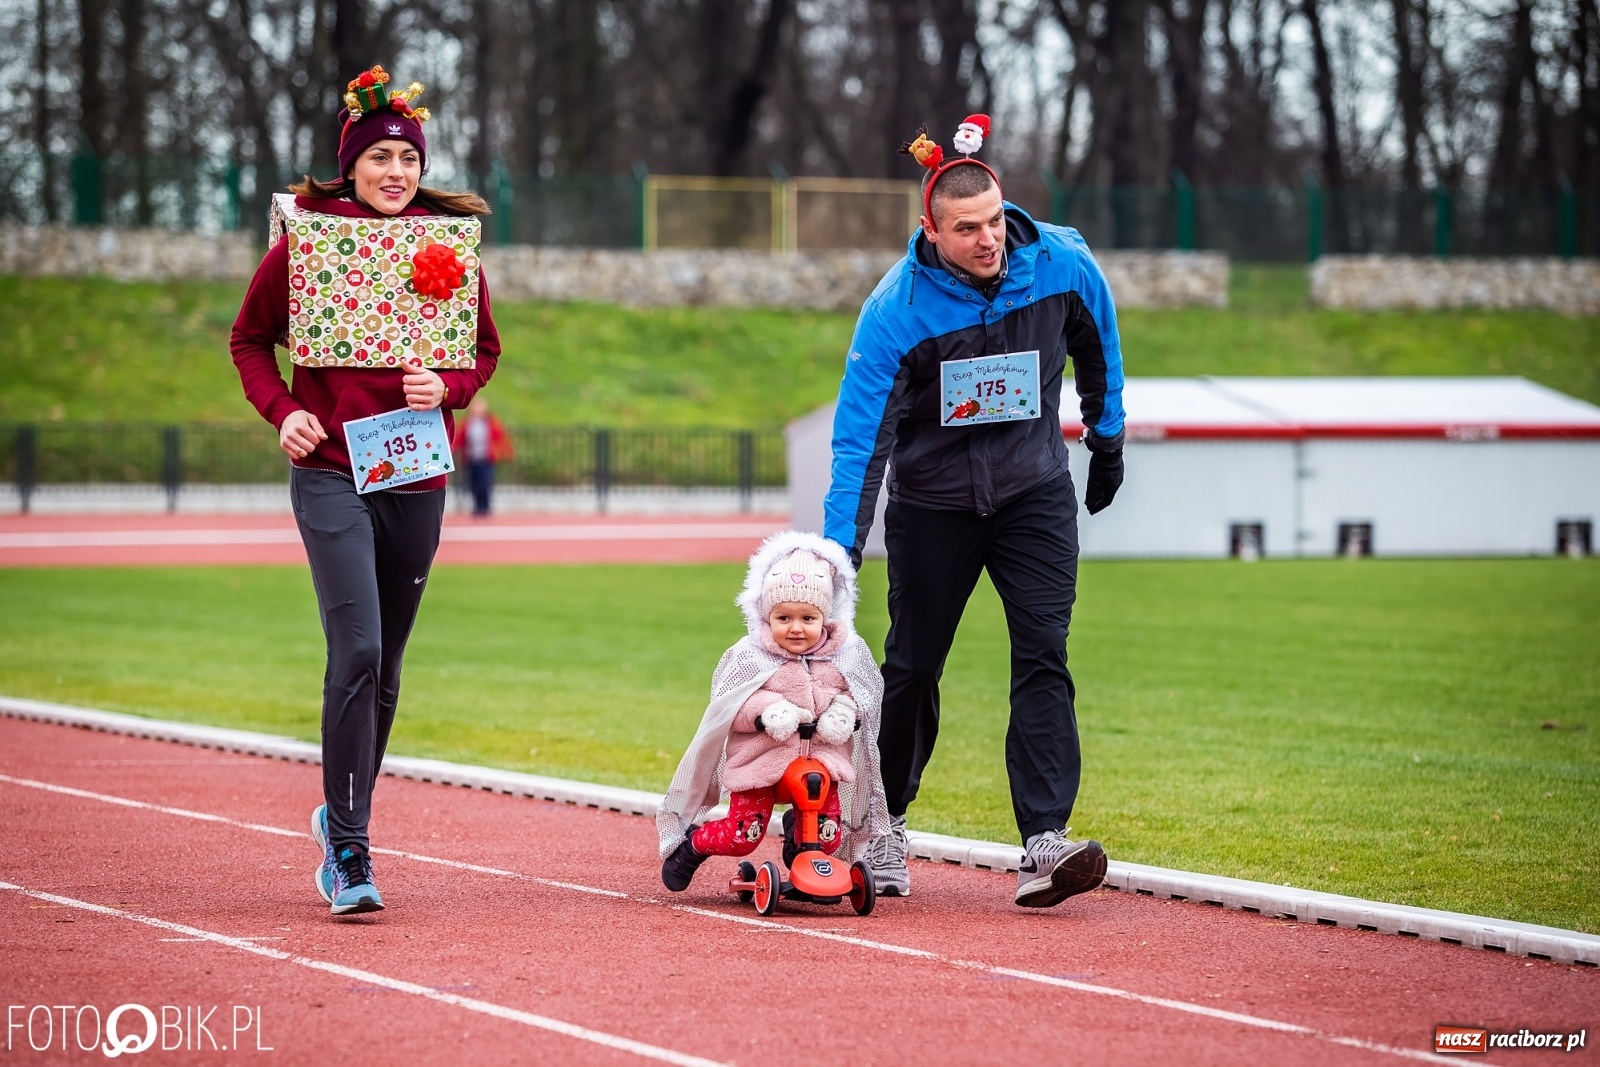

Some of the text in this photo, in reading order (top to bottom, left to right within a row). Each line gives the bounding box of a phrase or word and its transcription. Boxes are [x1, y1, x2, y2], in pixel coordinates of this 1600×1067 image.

[951, 370, 974, 382] Bieg
[975, 378, 1006, 398] 175
[357, 429, 380, 443] Bieg
[383, 433, 417, 458] 135
